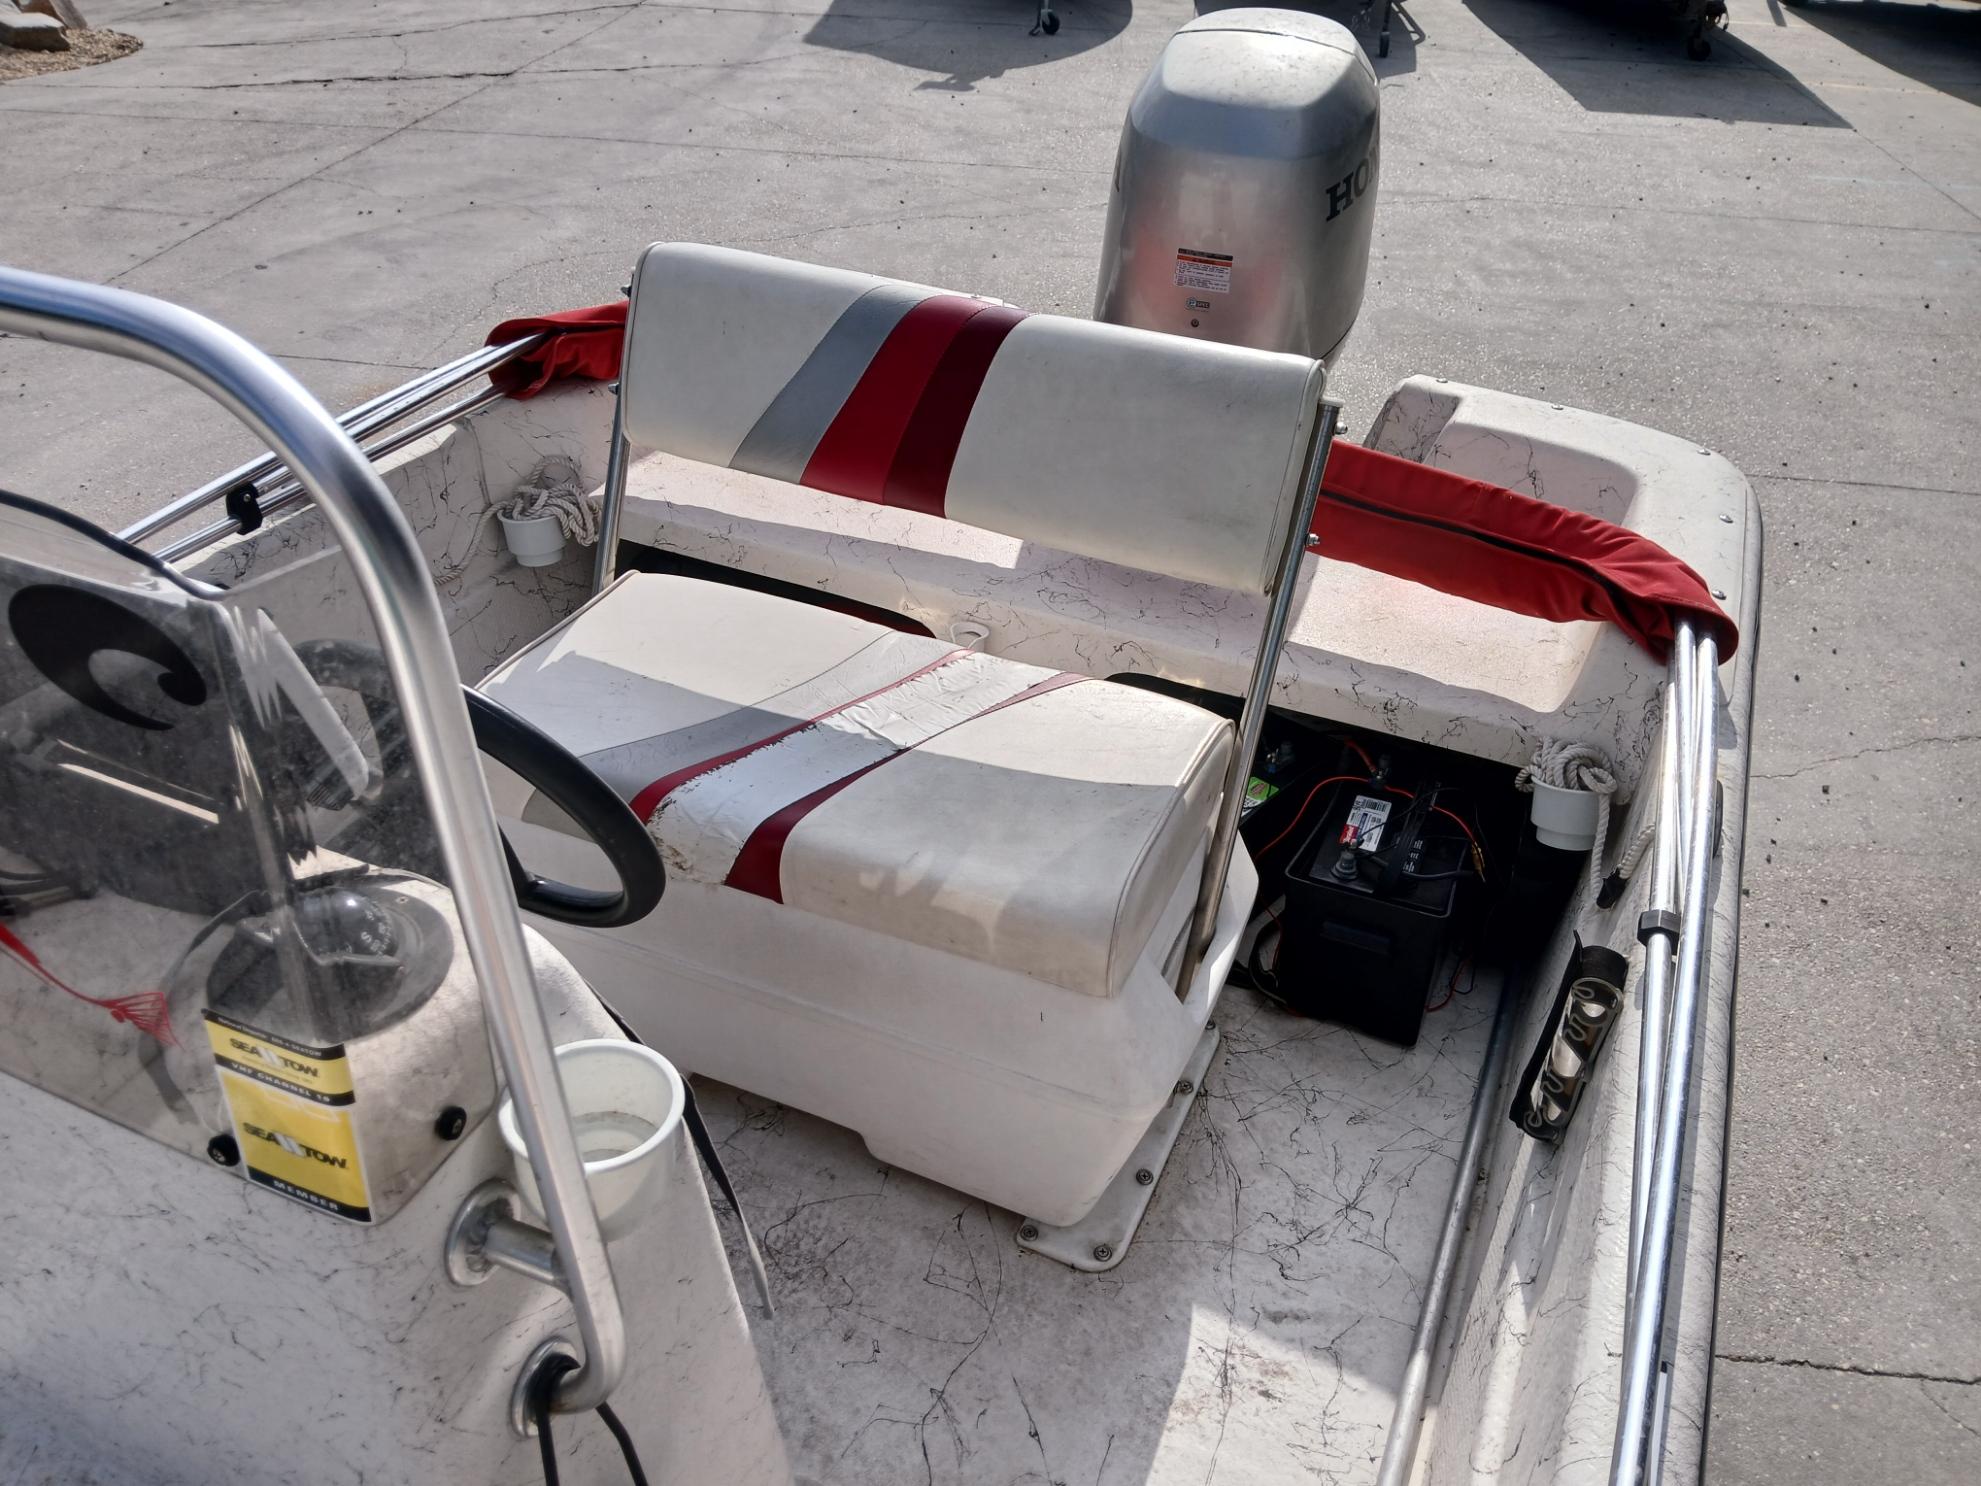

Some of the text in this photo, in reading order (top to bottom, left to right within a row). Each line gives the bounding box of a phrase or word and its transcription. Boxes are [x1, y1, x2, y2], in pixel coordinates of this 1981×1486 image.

[229, 1038, 263, 1057] SEA
[278, 1055, 319, 1077] TOW
[257, 1072, 312, 1097] CHANNEL
[243, 1122, 348, 1169] SEA TOW
[273, 1180, 339, 1210] MEMBER
